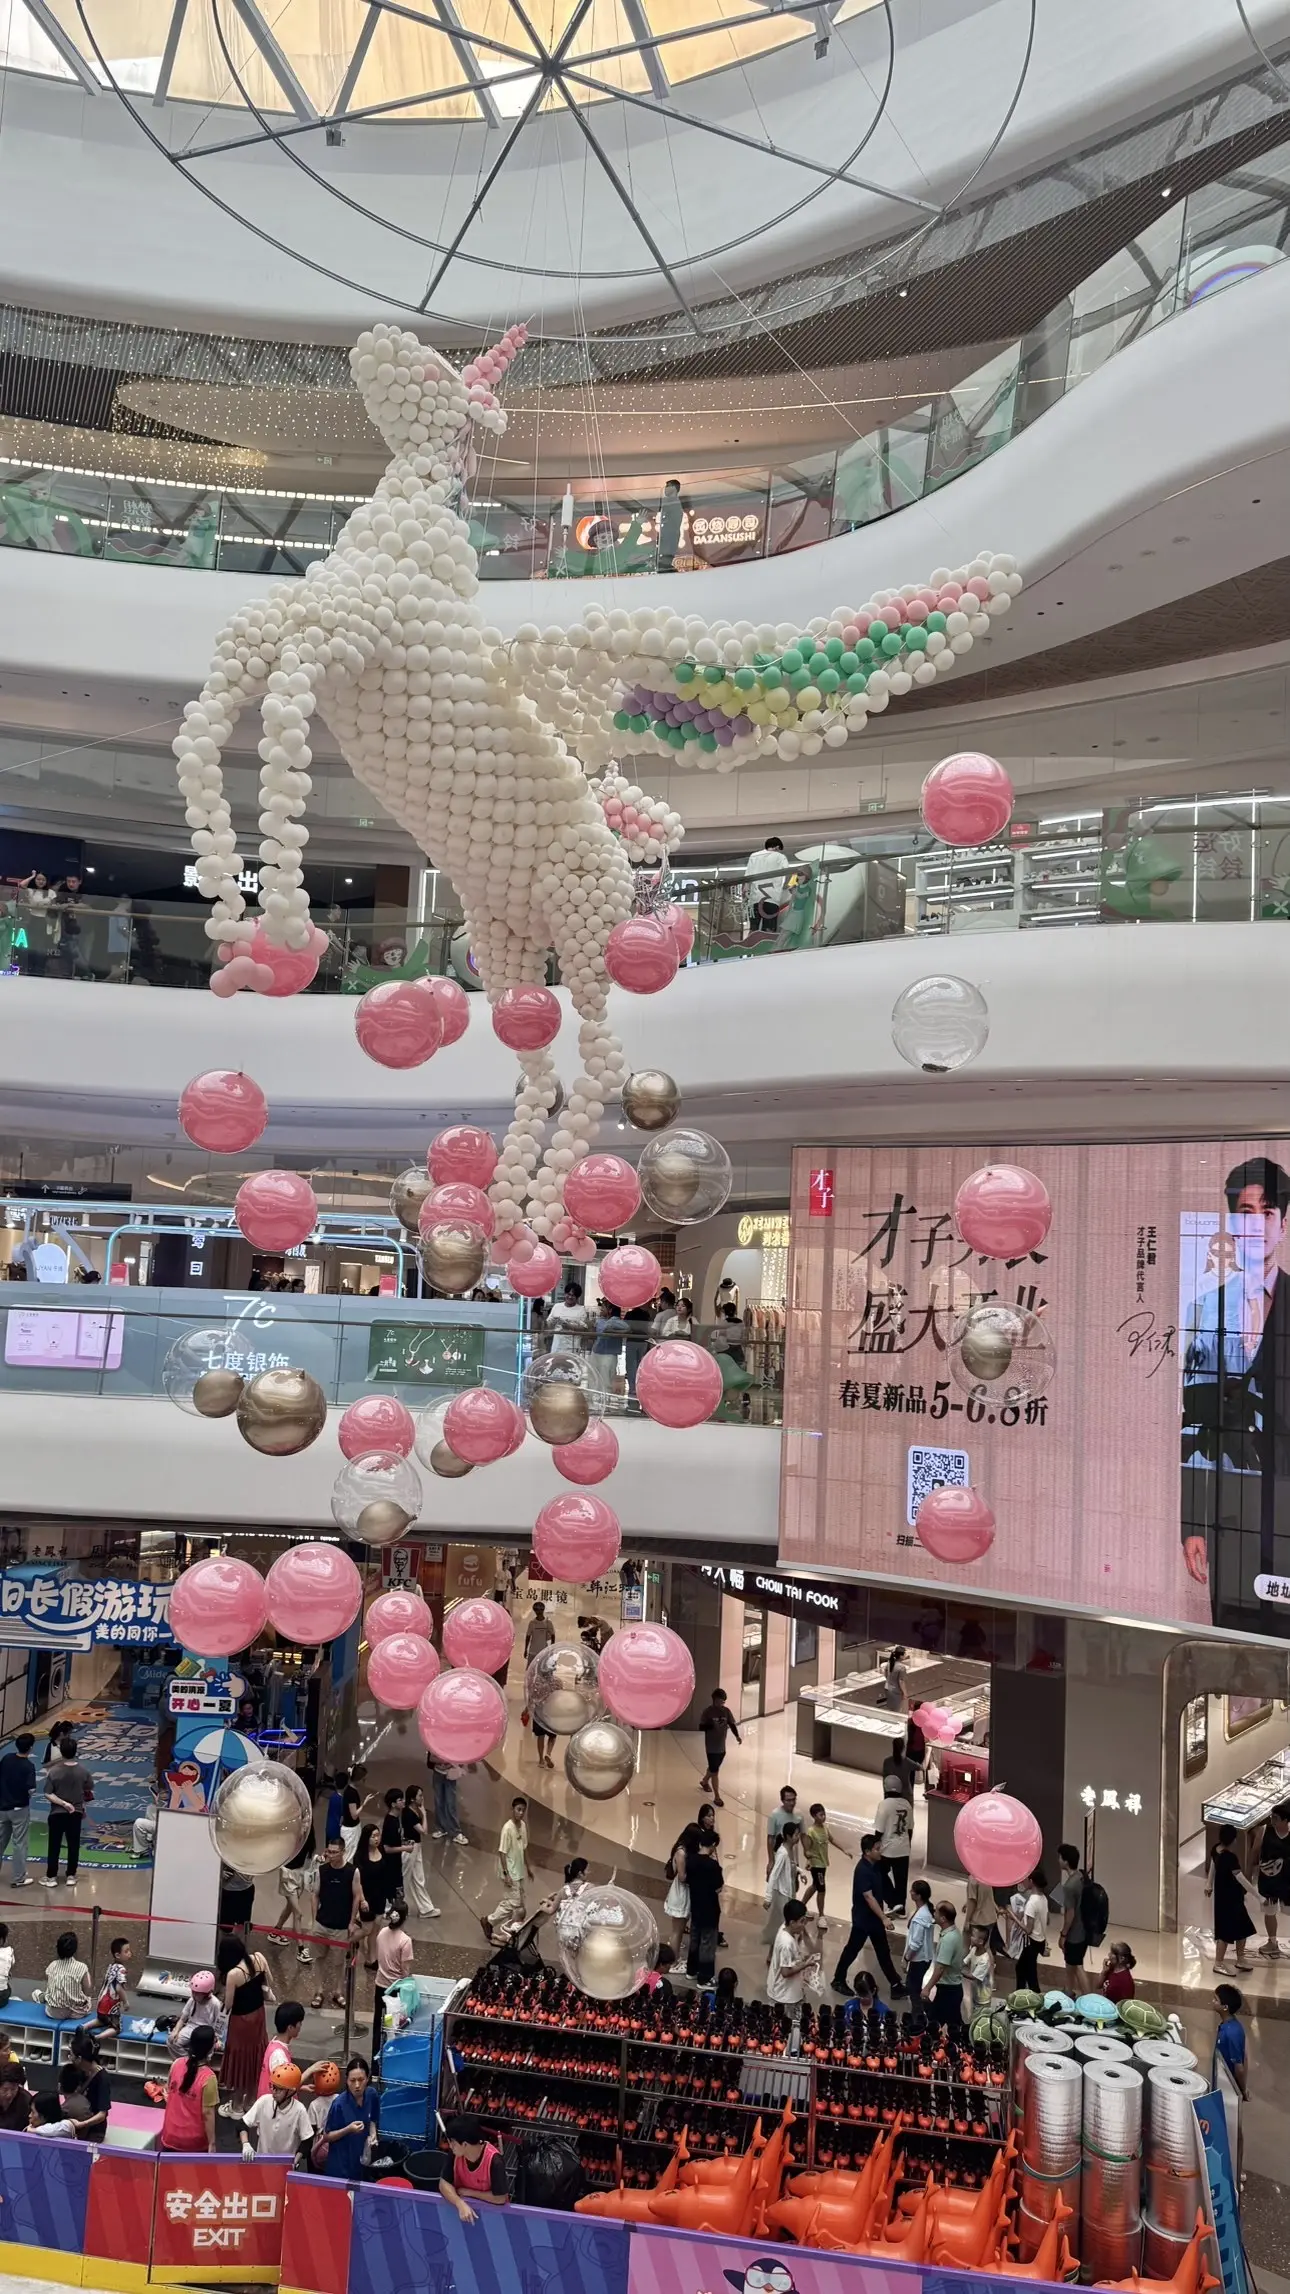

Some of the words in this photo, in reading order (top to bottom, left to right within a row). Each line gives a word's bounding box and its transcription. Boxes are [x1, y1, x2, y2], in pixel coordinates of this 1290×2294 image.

[693, 531, 756, 545] DAZANSUSHI
[810, 1169, 835, 1208] 才子
[1136, 1226, 1146, 1303] 才子品牌代言人
[201, 1350, 290, 1372] 七度银饰
[387, 1577, 412, 1588] KFC
[458, 1574, 483, 1586] fufu
[756, 1575, 783, 1595] CHOW
[785, 1584, 803, 1601] TAI
[806, 1590, 839, 1610] FOOK
[165, 2189, 277, 2219] 安全出口
[193, 2228, 246, 2247] EXIT
